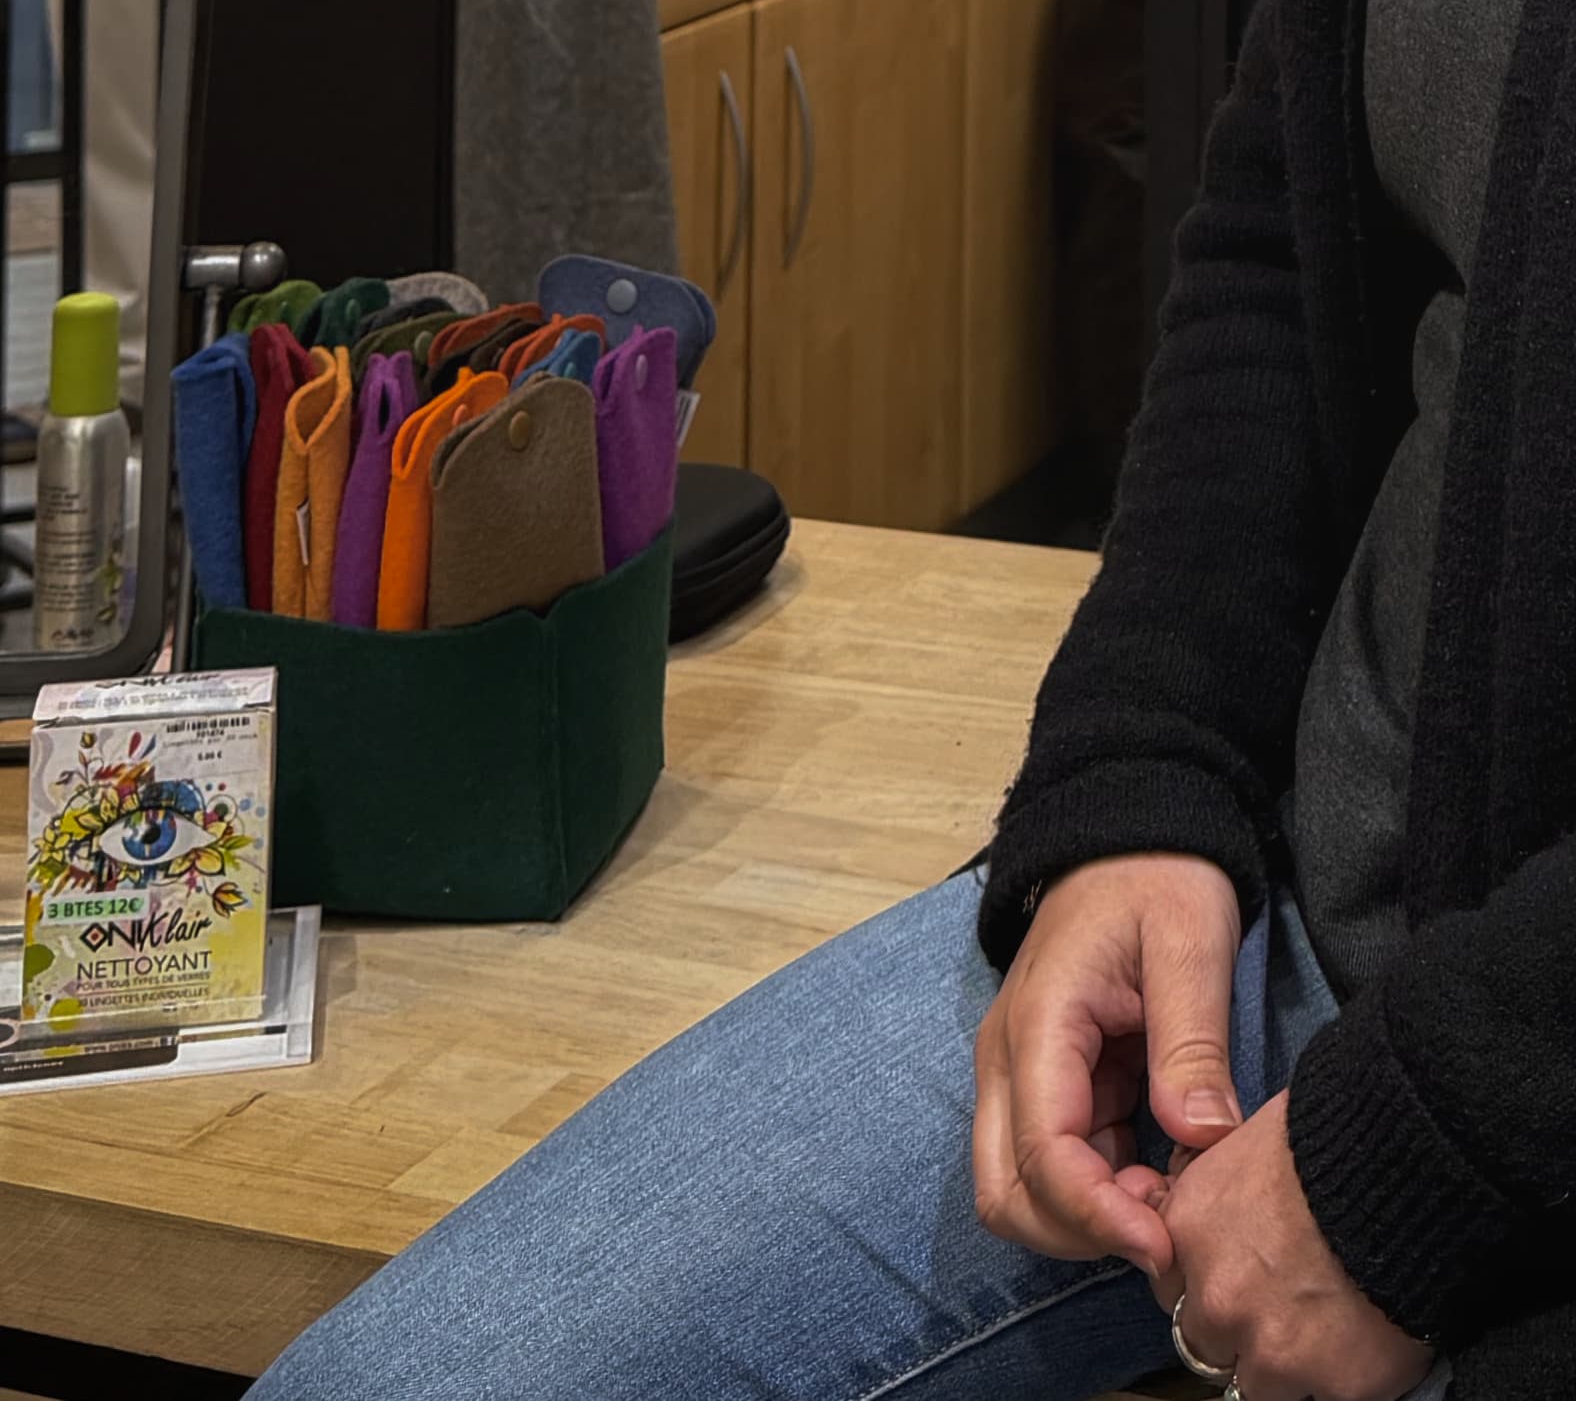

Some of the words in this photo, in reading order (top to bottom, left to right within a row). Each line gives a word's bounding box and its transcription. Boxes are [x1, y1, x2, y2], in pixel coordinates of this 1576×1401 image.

[49, 904, 58, 919] 3
[63, 900, 104, 917] BTES
[108, 897, 140, 913] 12€
[76, 950, 212, 981] NETTOYANT
